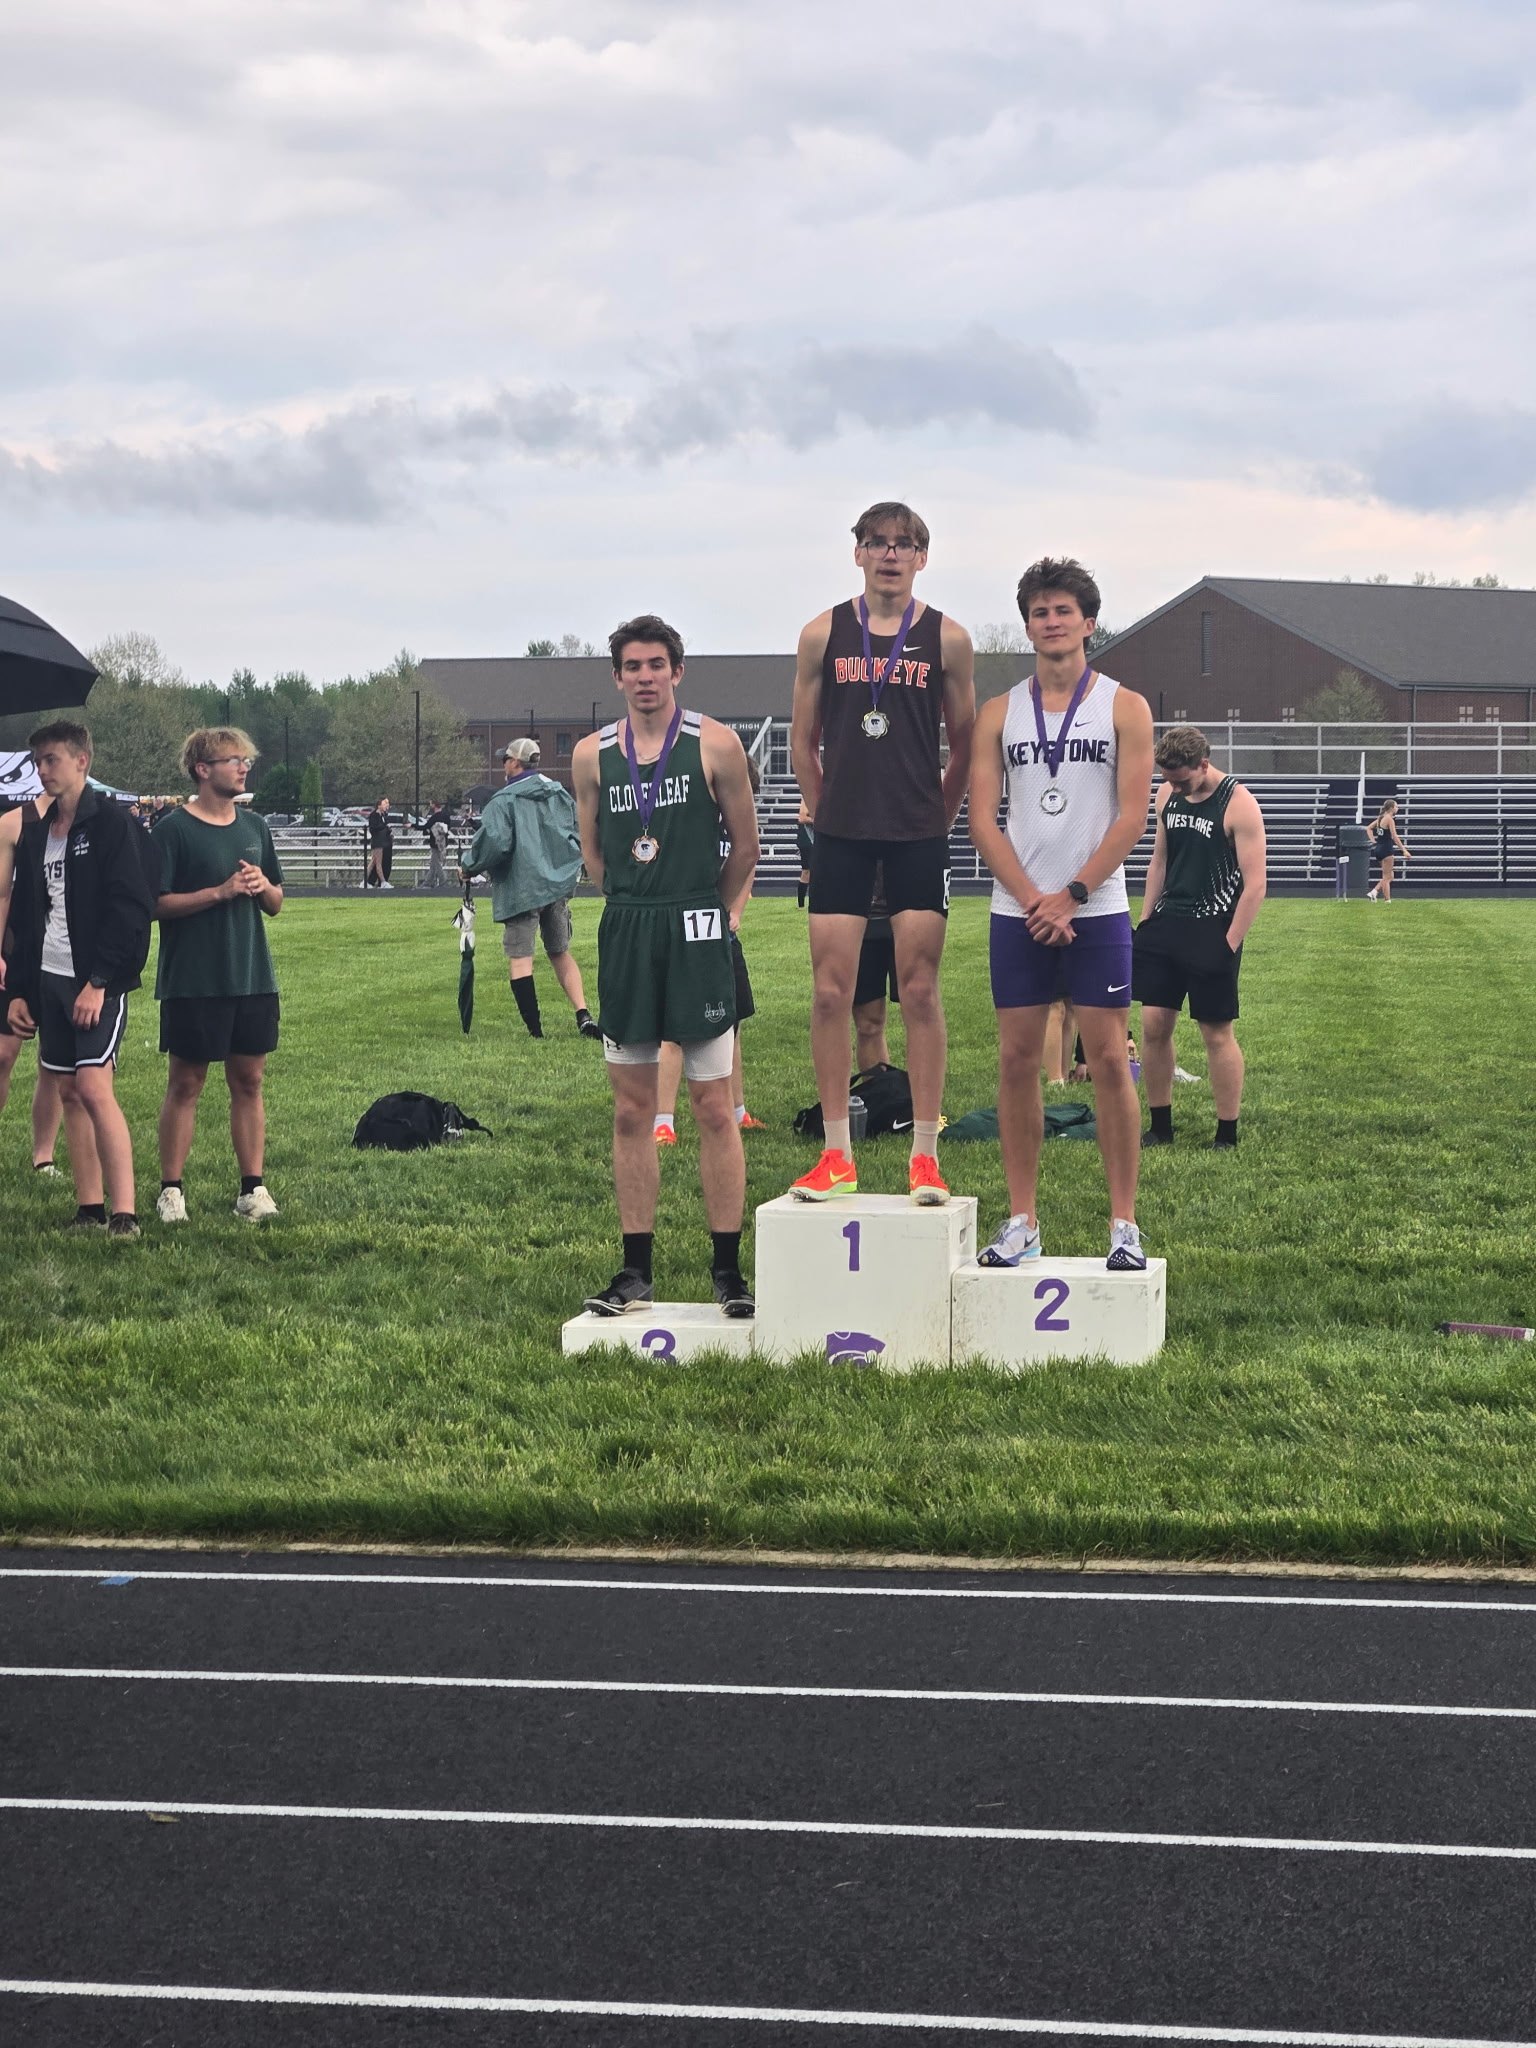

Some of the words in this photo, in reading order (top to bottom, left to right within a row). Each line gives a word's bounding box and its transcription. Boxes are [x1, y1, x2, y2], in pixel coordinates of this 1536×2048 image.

[835, 657, 931, 688] BUCKEYE
[1166, 813, 1214, 838] WESTLAKE
[687, 912, 715, 939] 17
[843, 1220, 860, 1271] 1
[1034, 1278, 1070, 1331] 2
[641, 1329, 677, 1365] 3
